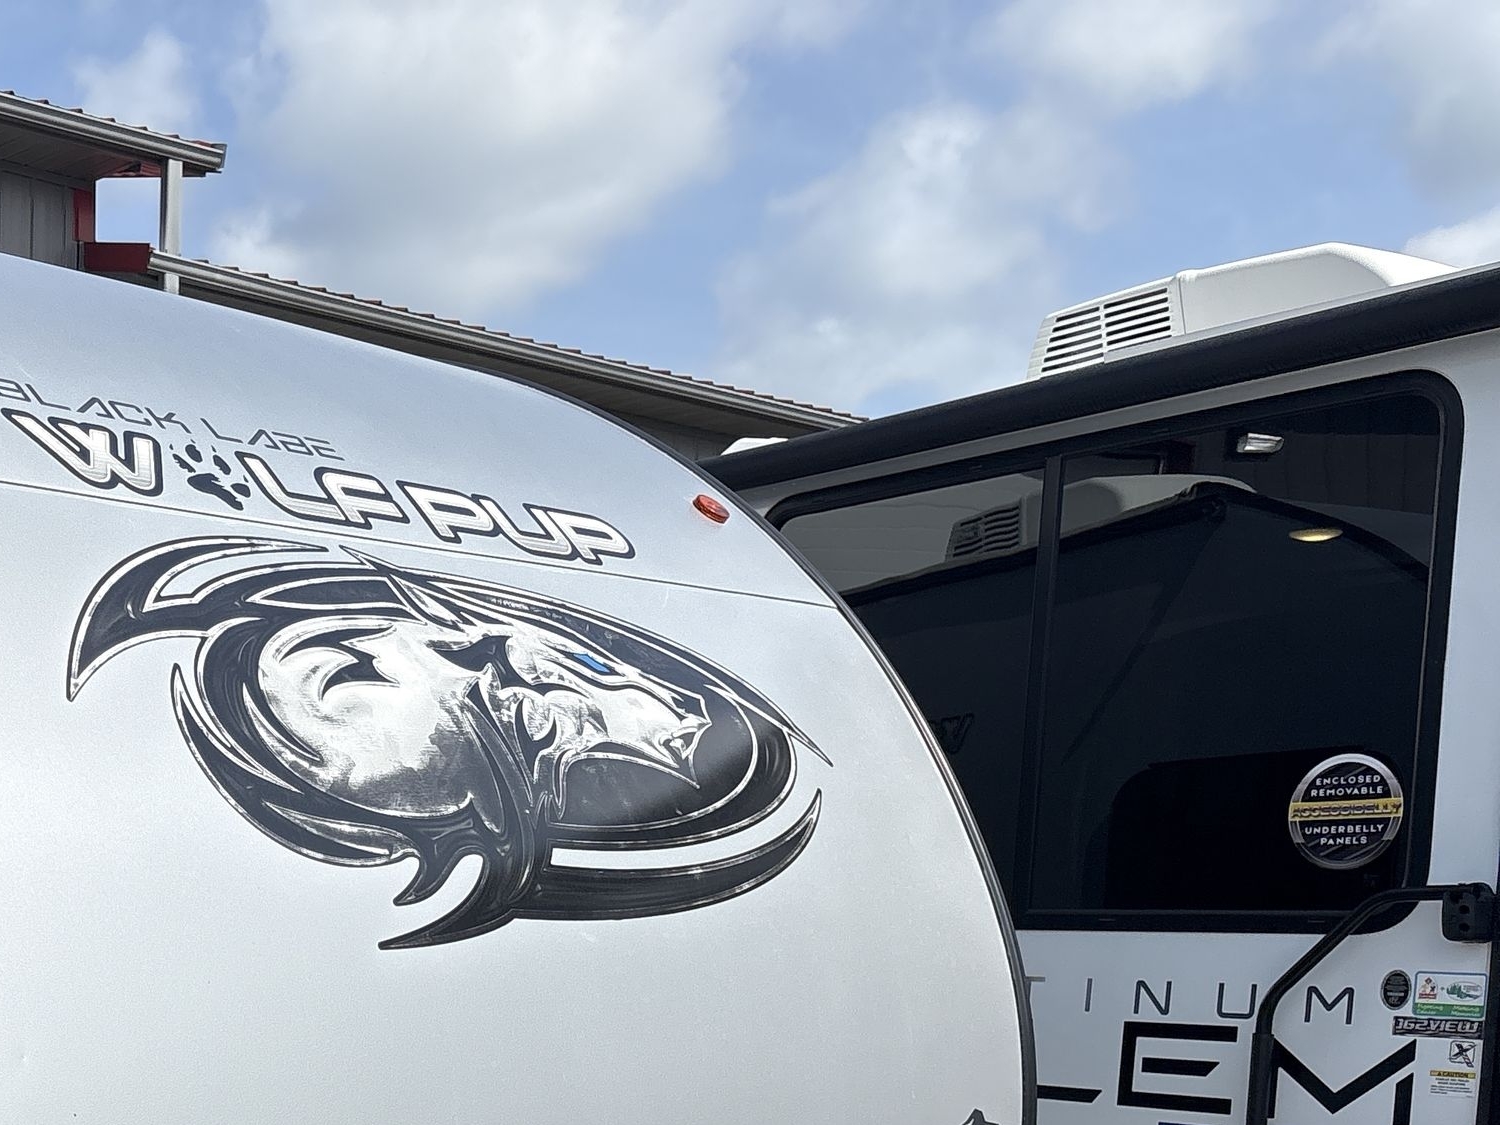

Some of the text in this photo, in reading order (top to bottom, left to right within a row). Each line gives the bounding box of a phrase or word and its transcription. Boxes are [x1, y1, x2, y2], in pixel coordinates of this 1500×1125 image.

[395, 479, 636, 566] PUP
[1315, 774, 1381, 786] ENCLOSED
[1310, 786, 1384, 797] REMOVABLE
[1304, 824, 1385, 835] UNDERBELLY
[1320, 836, 1368, 846] PANELS
